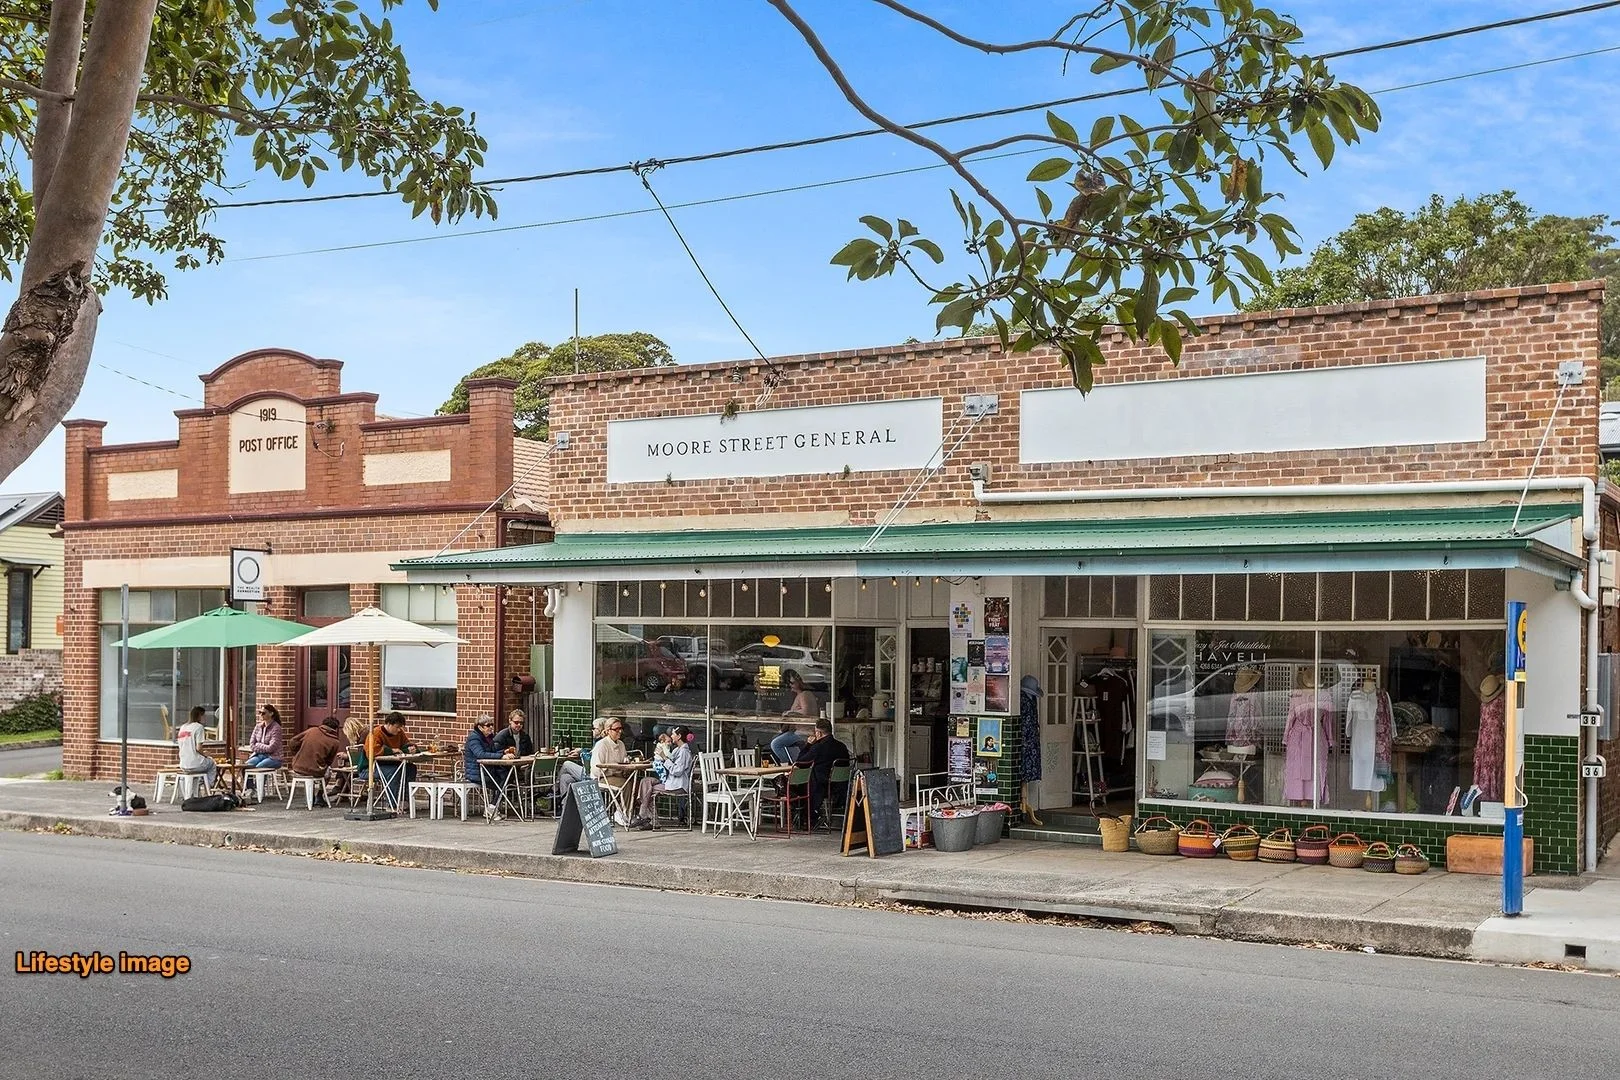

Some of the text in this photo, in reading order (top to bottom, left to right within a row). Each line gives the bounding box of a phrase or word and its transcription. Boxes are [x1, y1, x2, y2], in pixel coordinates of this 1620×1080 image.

[259, 408, 277, 422] 1919
[239, 435, 298, 453] POST OFFICE
[647, 429, 896, 457] MOORE STREET GENERAL
[1230, 640, 1271, 650] Middleton
[1583, 716, 1596, 725] 38
[1585, 767, 1598, 776] 36
